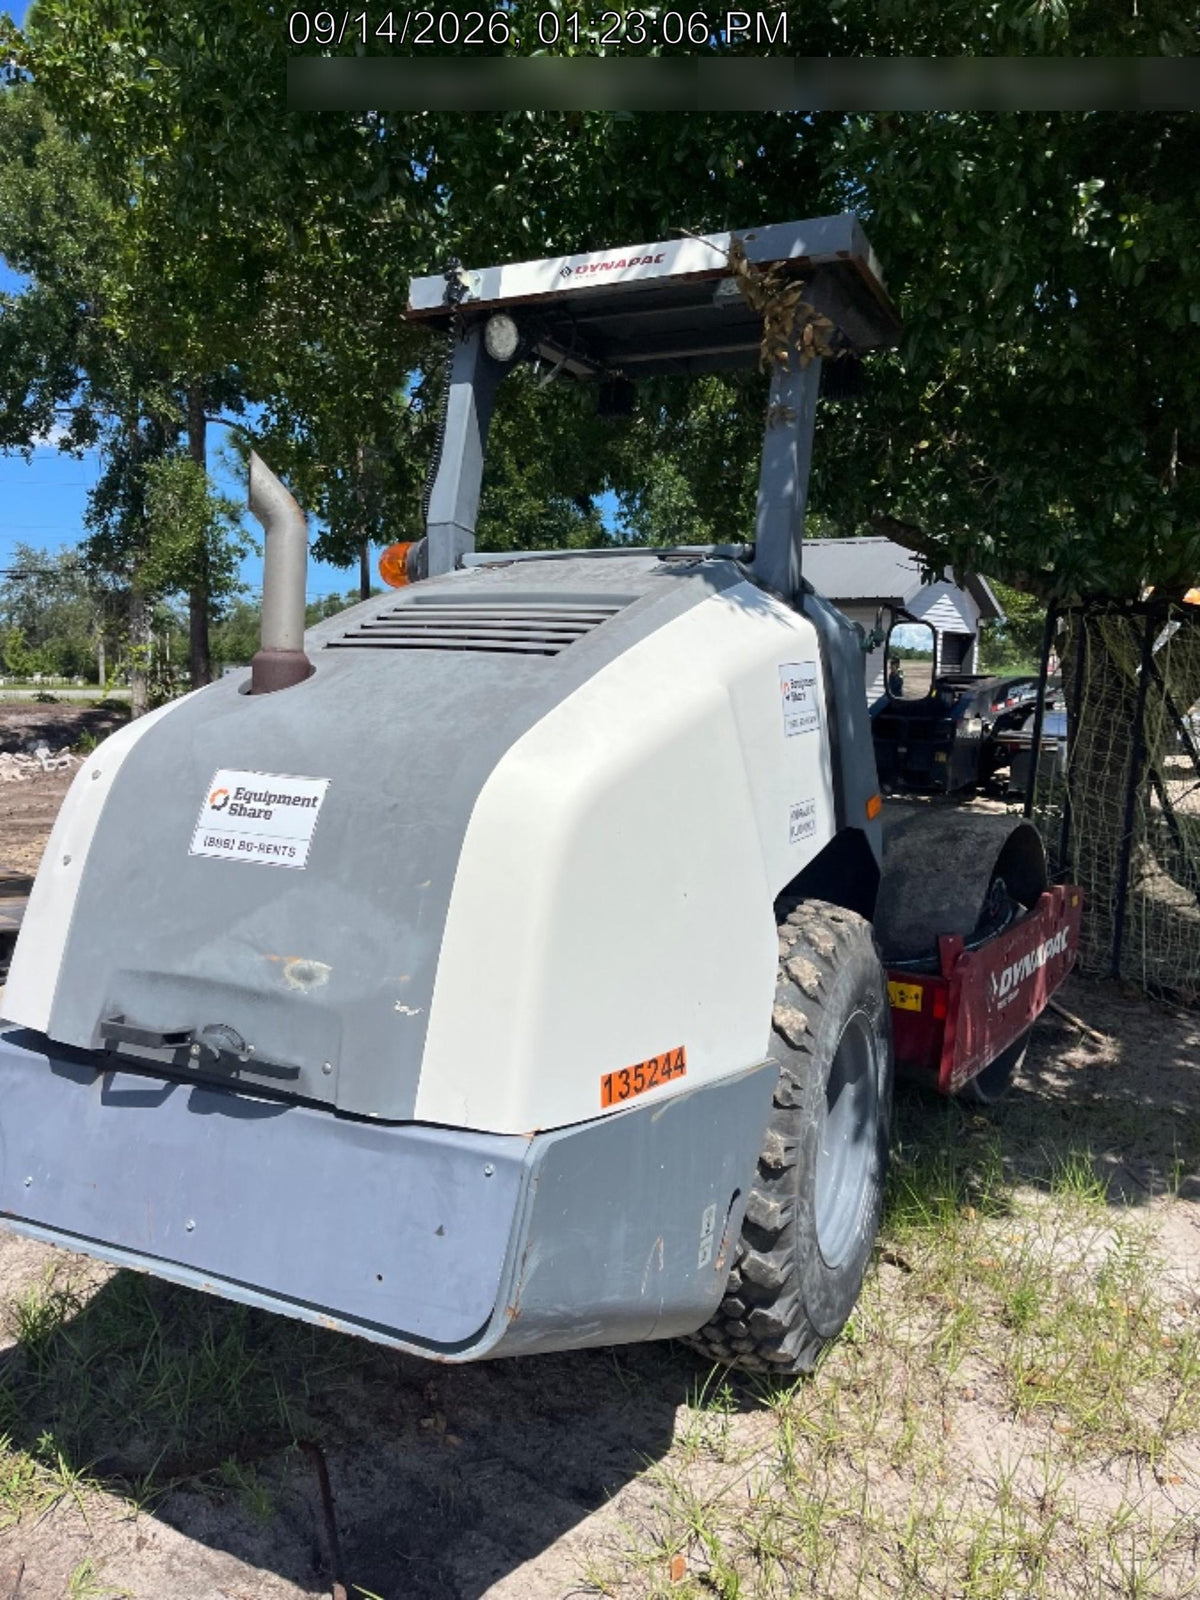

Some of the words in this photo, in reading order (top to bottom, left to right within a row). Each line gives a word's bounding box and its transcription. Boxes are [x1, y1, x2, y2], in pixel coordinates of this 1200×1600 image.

[575, 253, 666, 275] DYNAPAC
[234, 787, 319, 808] Equipment
[228, 803, 273, 820] Share
[998, 925, 1070, 997] DYNAPAC
[603, 1046, 685, 1103] 135244
